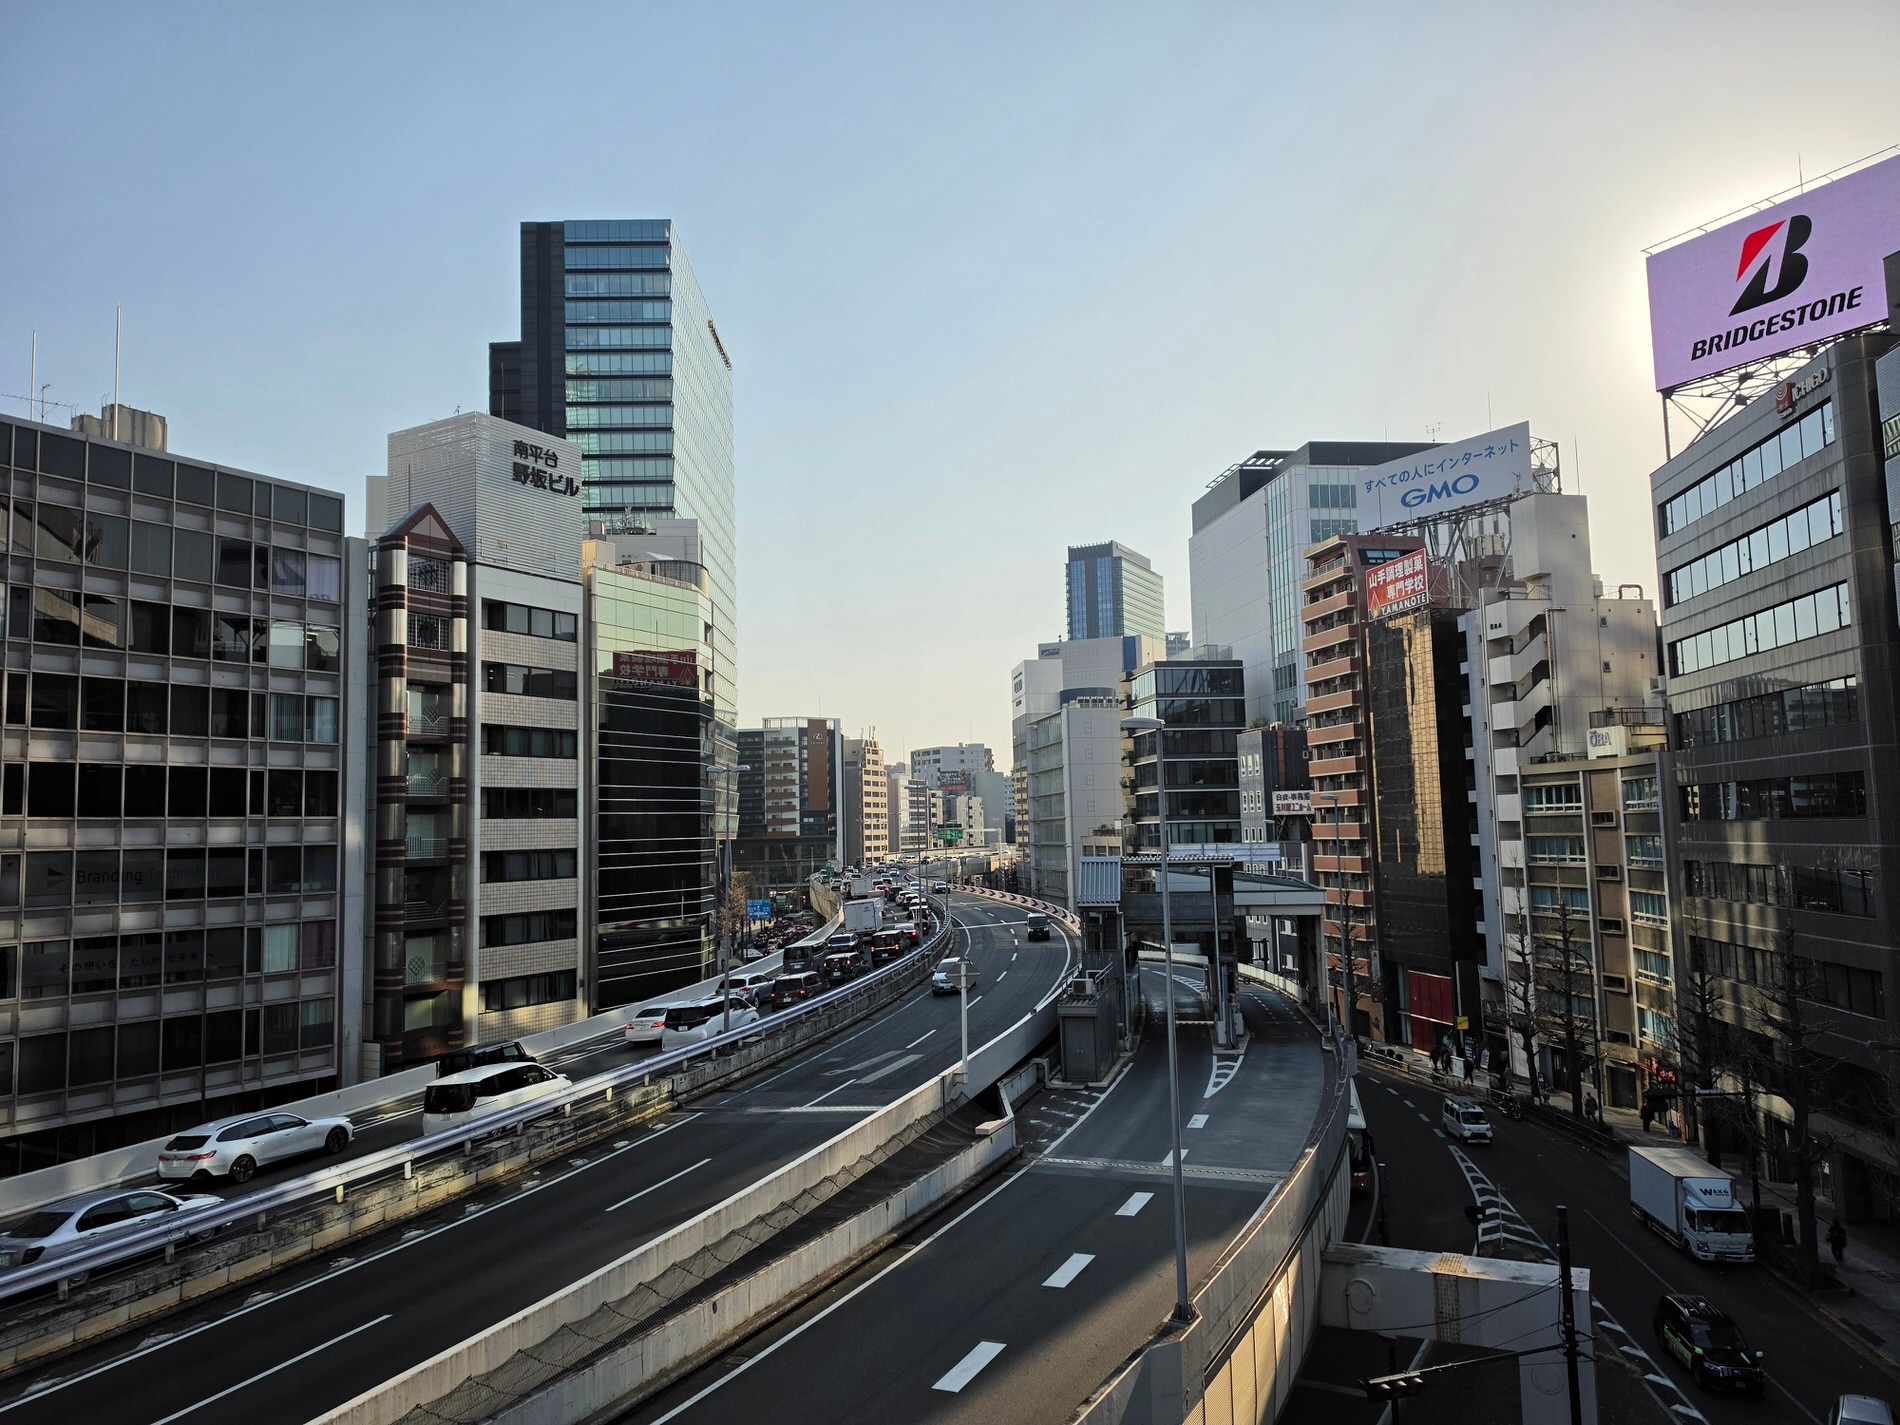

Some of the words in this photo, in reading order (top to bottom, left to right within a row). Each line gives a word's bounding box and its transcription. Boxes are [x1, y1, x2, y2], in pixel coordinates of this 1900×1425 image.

[1690, 285, 1864, 362] BRIDGESTONE
[1791, 367, 1829, 402] ICHIGO
[513, 439, 559, 469] 南平台
[1364, 438, 1519, 494] すべての人にインターネット
[512, 461, 580, 497] 野坂ビル
[1400, 473, 1480, 508] GMO
[1368, 554, 1424, 589] 山手調理製菓
[1386, 575, 1425, 600] 専門学校
[1380, 592, 1426, 617] YAMANOTE
[76, 869, 143, 885] Branding
